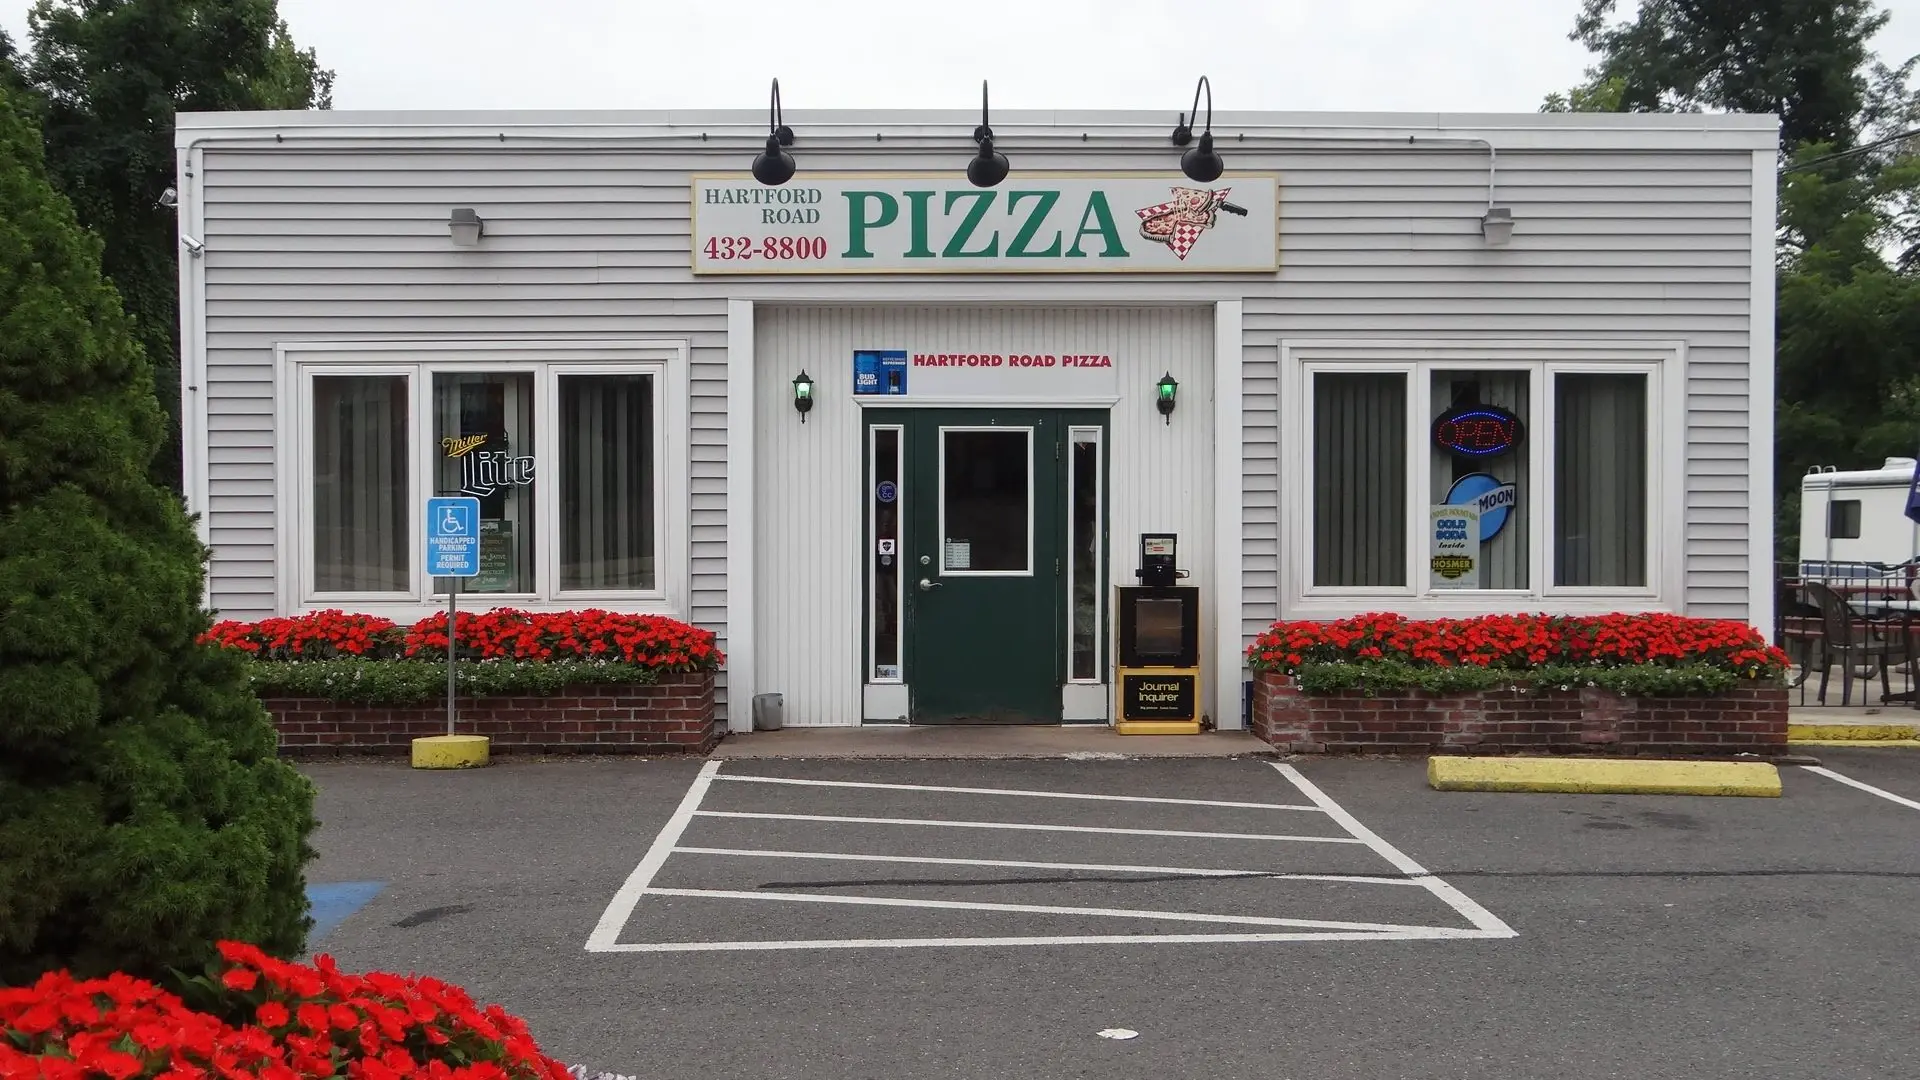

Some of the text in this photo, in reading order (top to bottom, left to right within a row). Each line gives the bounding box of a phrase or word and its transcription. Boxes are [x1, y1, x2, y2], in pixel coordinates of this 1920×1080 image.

[705, 188, 823, 205] HARTFORD
[761, 207, 821, 225] ROAD
[841, 189, 1130, 259] PIZZA
[703, 236, 827, 261] 432-8800
[914, 354, 1112, 368] HARTFORD ROAD PIZZA
[1438, 420, 1515, 447] OPEN
[442, 433, 488, 452] Miller
[460, 450, 536, 497] Lite
[1479, 488, 1514, 512] MOON
[1437, 519, 1467, 529] COLD
[436, 561, 469, 569] REQUIRED
[1432, 560, 1471, 568] HOSMER
[1139, 682, 1180, 691] Journal
[1139, 692, 1179, 703] Inquirer
